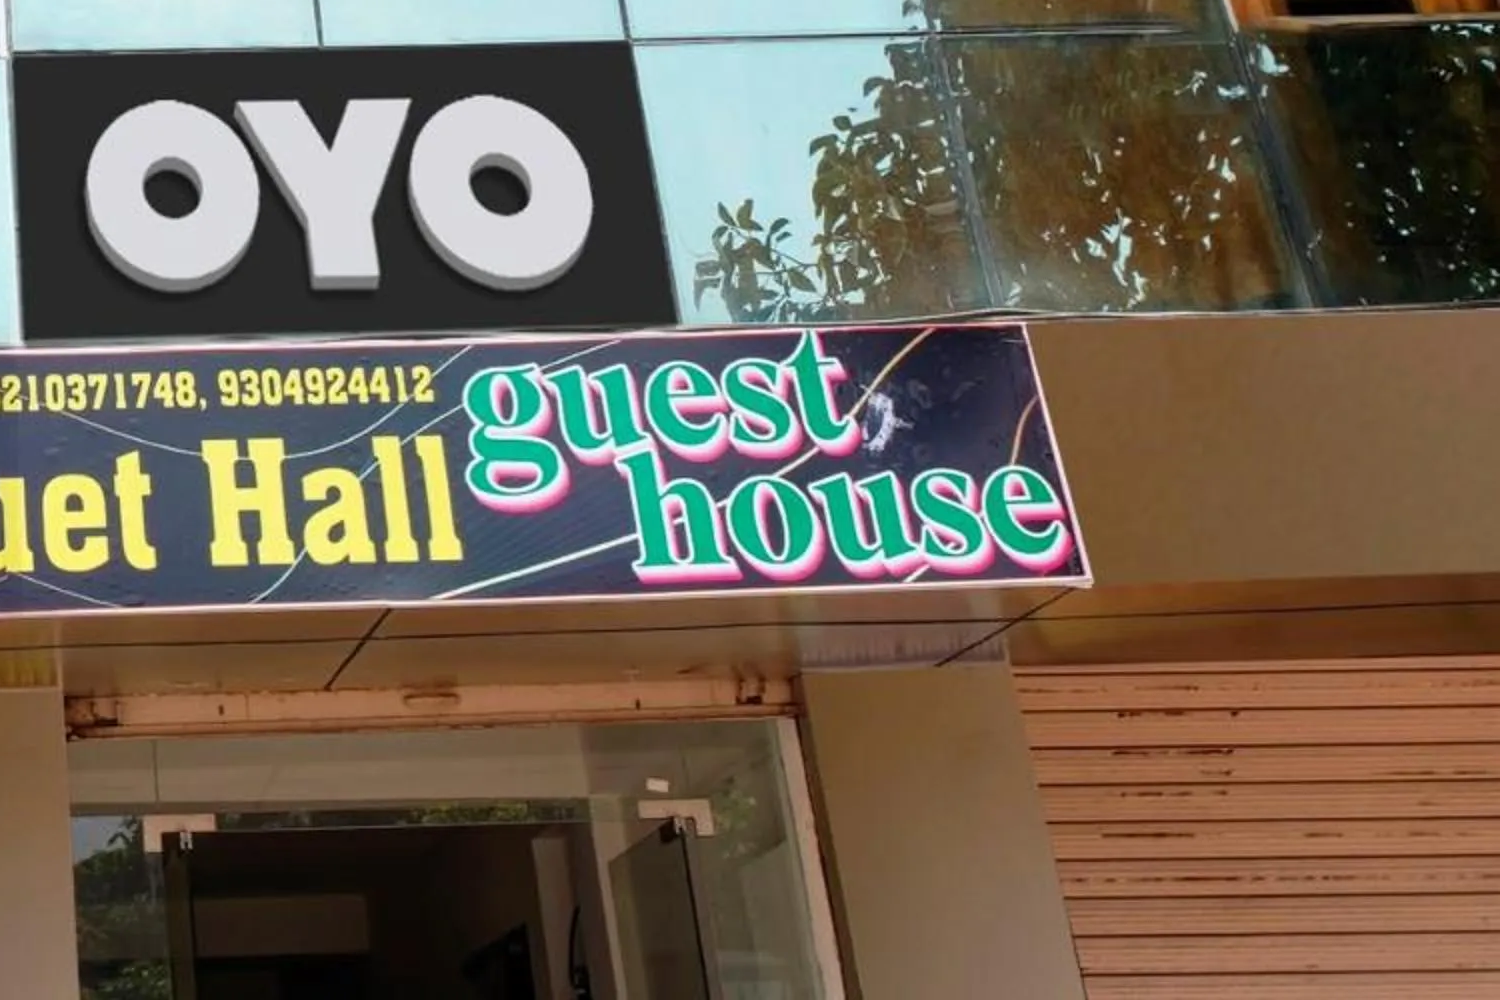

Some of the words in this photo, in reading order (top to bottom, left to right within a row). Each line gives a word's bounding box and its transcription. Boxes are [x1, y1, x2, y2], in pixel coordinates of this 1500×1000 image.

[85, 95, 594, 293] OYO
[217, 366, 435, 407] 9304924412
[462, 328, 862, 513] guest
[201, 434, 464, 567] Hall
[614, 446, 1072, 583] house
